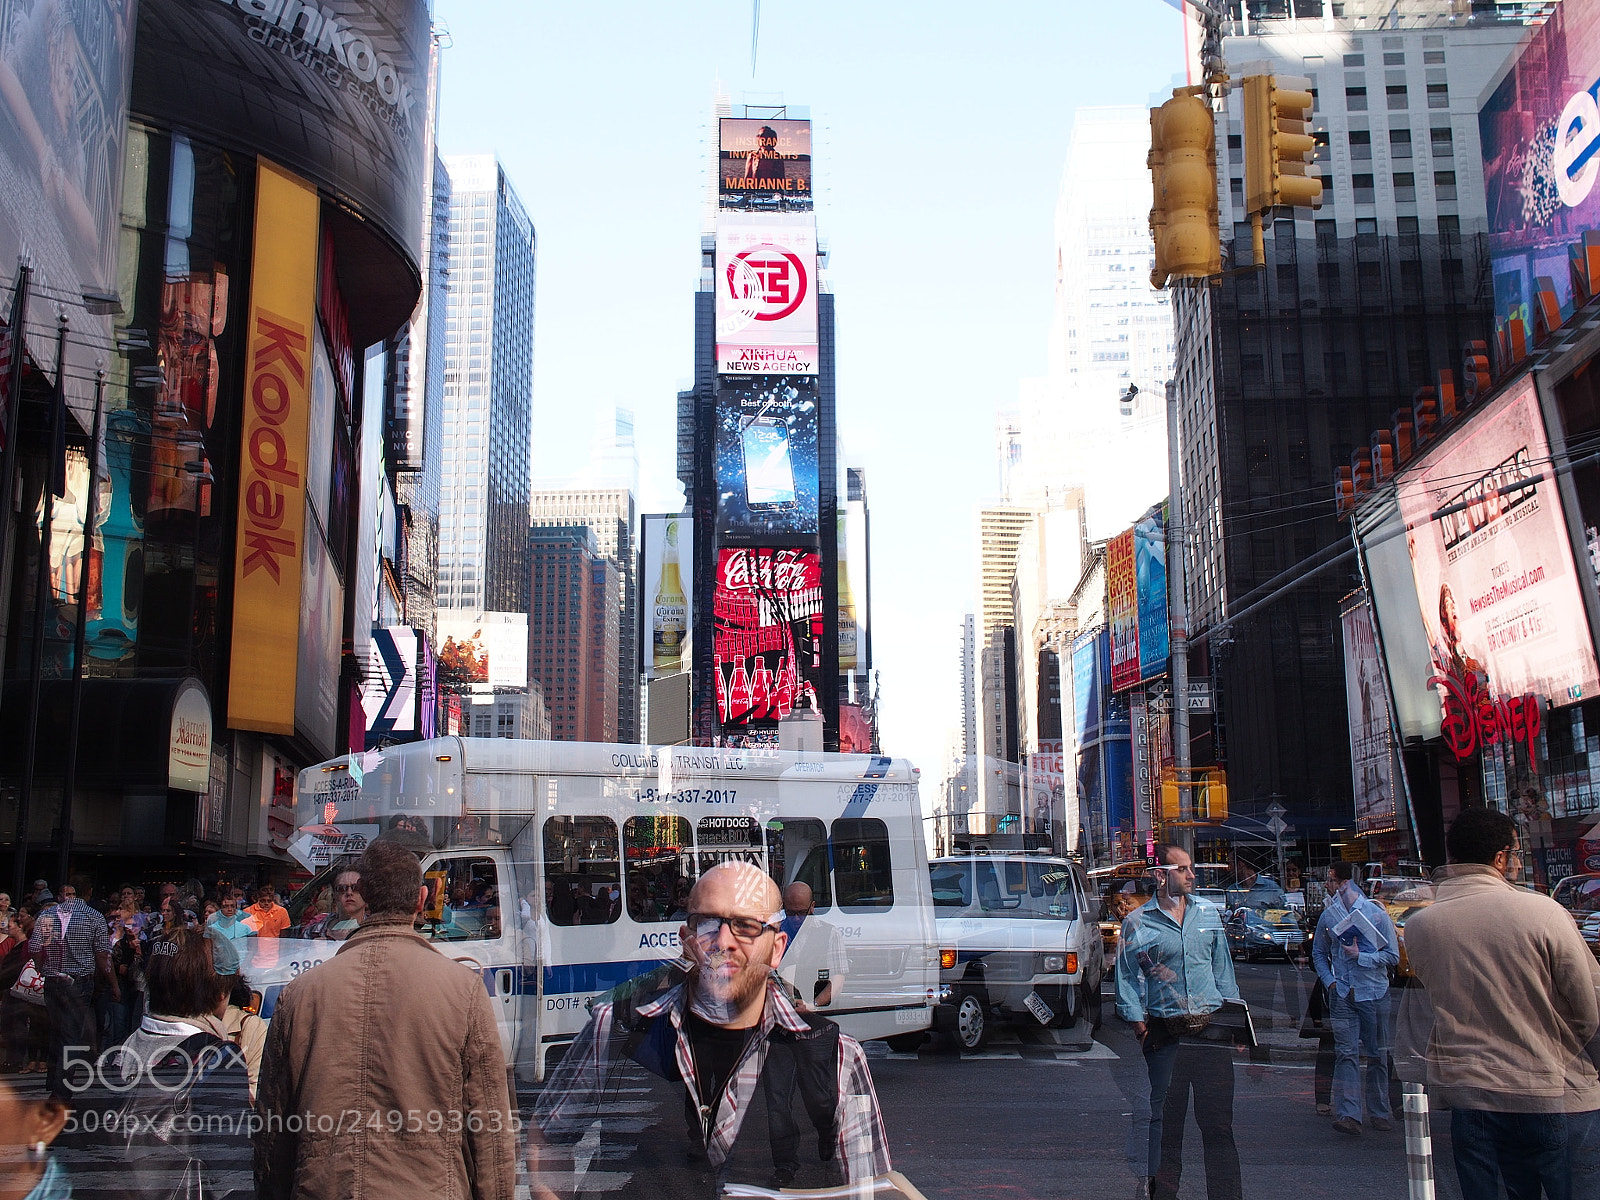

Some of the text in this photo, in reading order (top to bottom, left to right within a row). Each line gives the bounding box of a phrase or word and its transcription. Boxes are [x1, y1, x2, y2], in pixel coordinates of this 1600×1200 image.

[219, 0, 417, 131] ankook
[735, 136, 793, 147] INSURANCE
[729, 151, 799, 160] INVESTMENTS
[725, 177, 810, 191] MARIANNE B.
[739, 349, 798, 361] XINHUA
[726, 362, 811, 372] NEWS AGENCY
[741, 399, 760, 407] Best
[773, 399, 793, 408] both
[246, 306, 307, 587] Kodak
[1513, 499, 1540, 522] MUSICAL
[1109, 571, 1134, 599] GOES
[1469, 566, 1545, 615] NewsiesTheMusical.com
[656, 606, 684, 617] Corona
[175, 727, 207, 748] Marriott
[676, 755, 721, 769] TRANSIT
[794, 762, 825, 773] OPERATOR
[1137, 716, 1151, 813] PALACE
[314, 777, 360, 792] ACCESS-A-RIDE
[837, 783, 918, 794] ACCESS-A-RIDE
[313, 788, 360, 805] 1-877-337-2017
[836, 792, 917, 804] 1-877-337-2017
[709, 818, 726, 828] HOT
[726, 818, 750, 828] DOGS
[343, 840, 368, 853] EYES
[1548, 863, 1574, 877] GLITCH!
[152, 941, 179, 957] GAP
[546, 998, 580, 1011] DOT#
